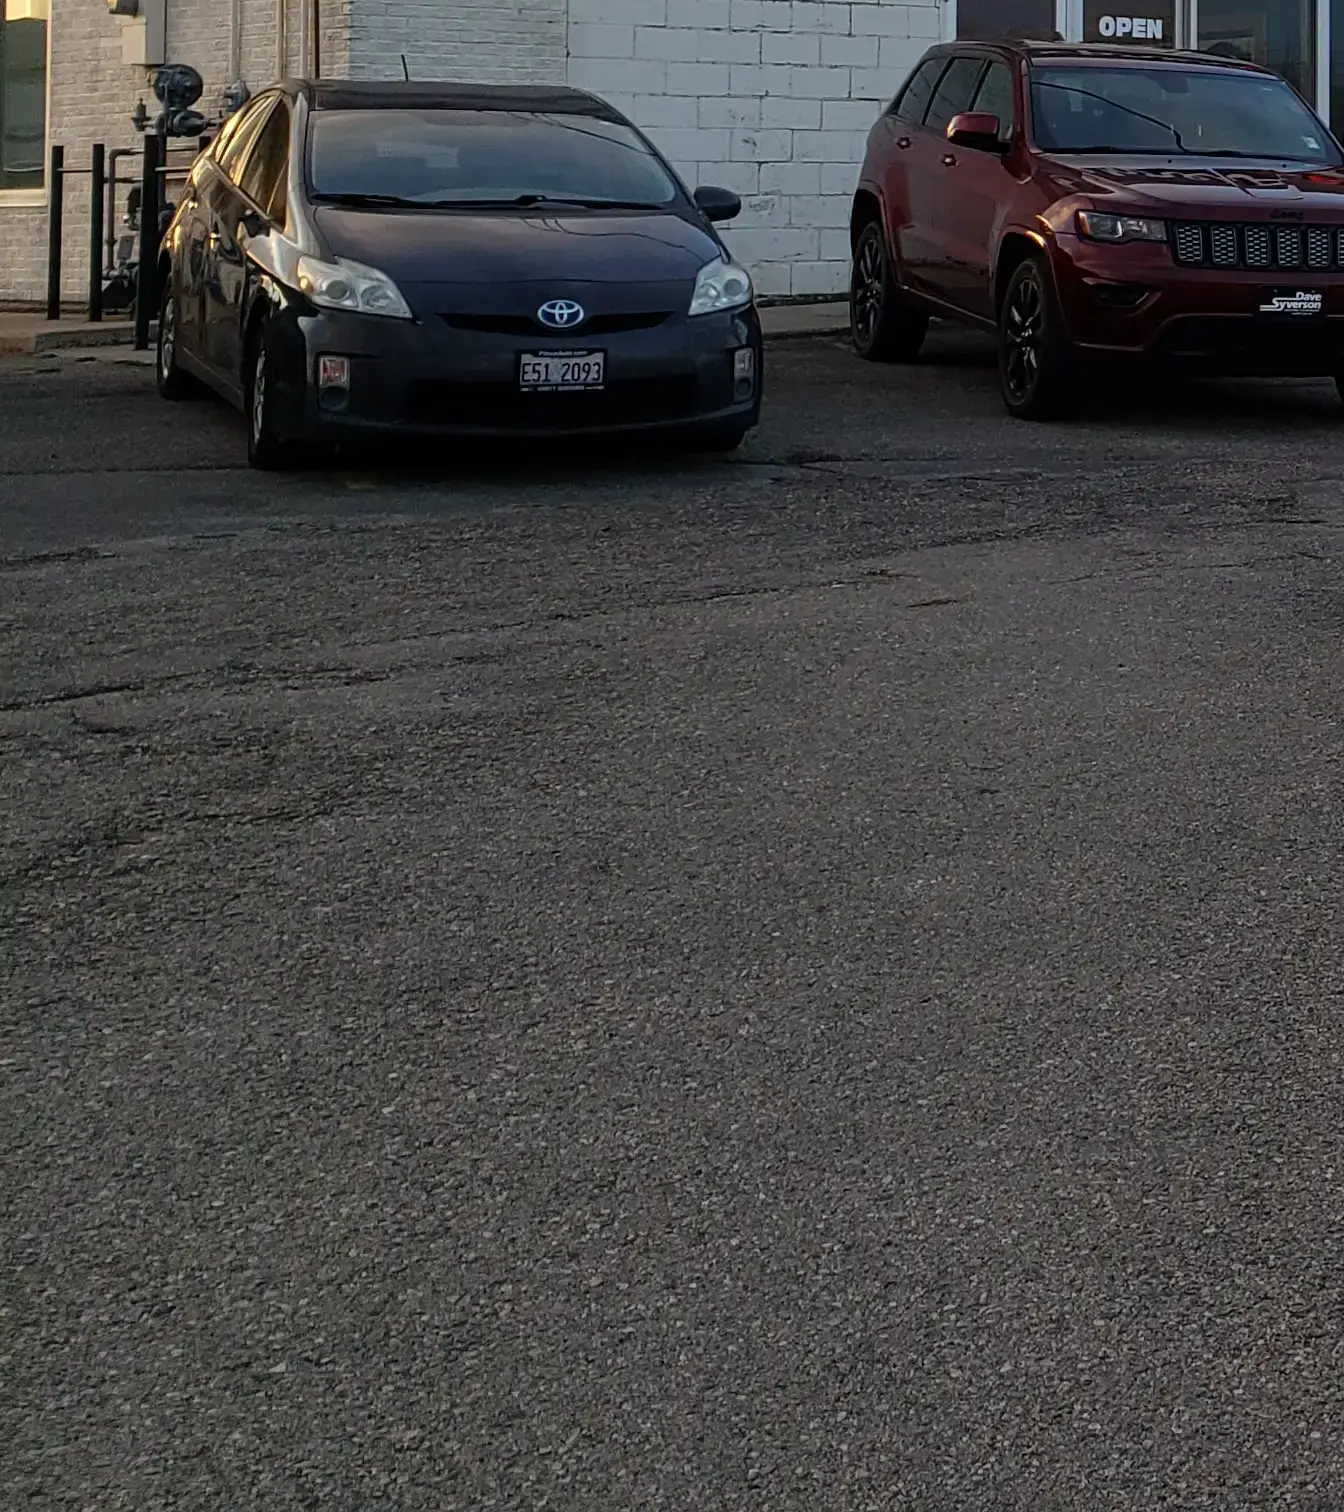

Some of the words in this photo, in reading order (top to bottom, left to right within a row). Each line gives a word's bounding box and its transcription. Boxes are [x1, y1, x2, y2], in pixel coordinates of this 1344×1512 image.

[1098, 15, 1163, 40] OPEN
[1265, 297, 1322, 311] Syverson
[1296, 291, 1322, 301] Dave
[522, 362, 551, 382] E51
[561, 362, 601, 382] 2093
